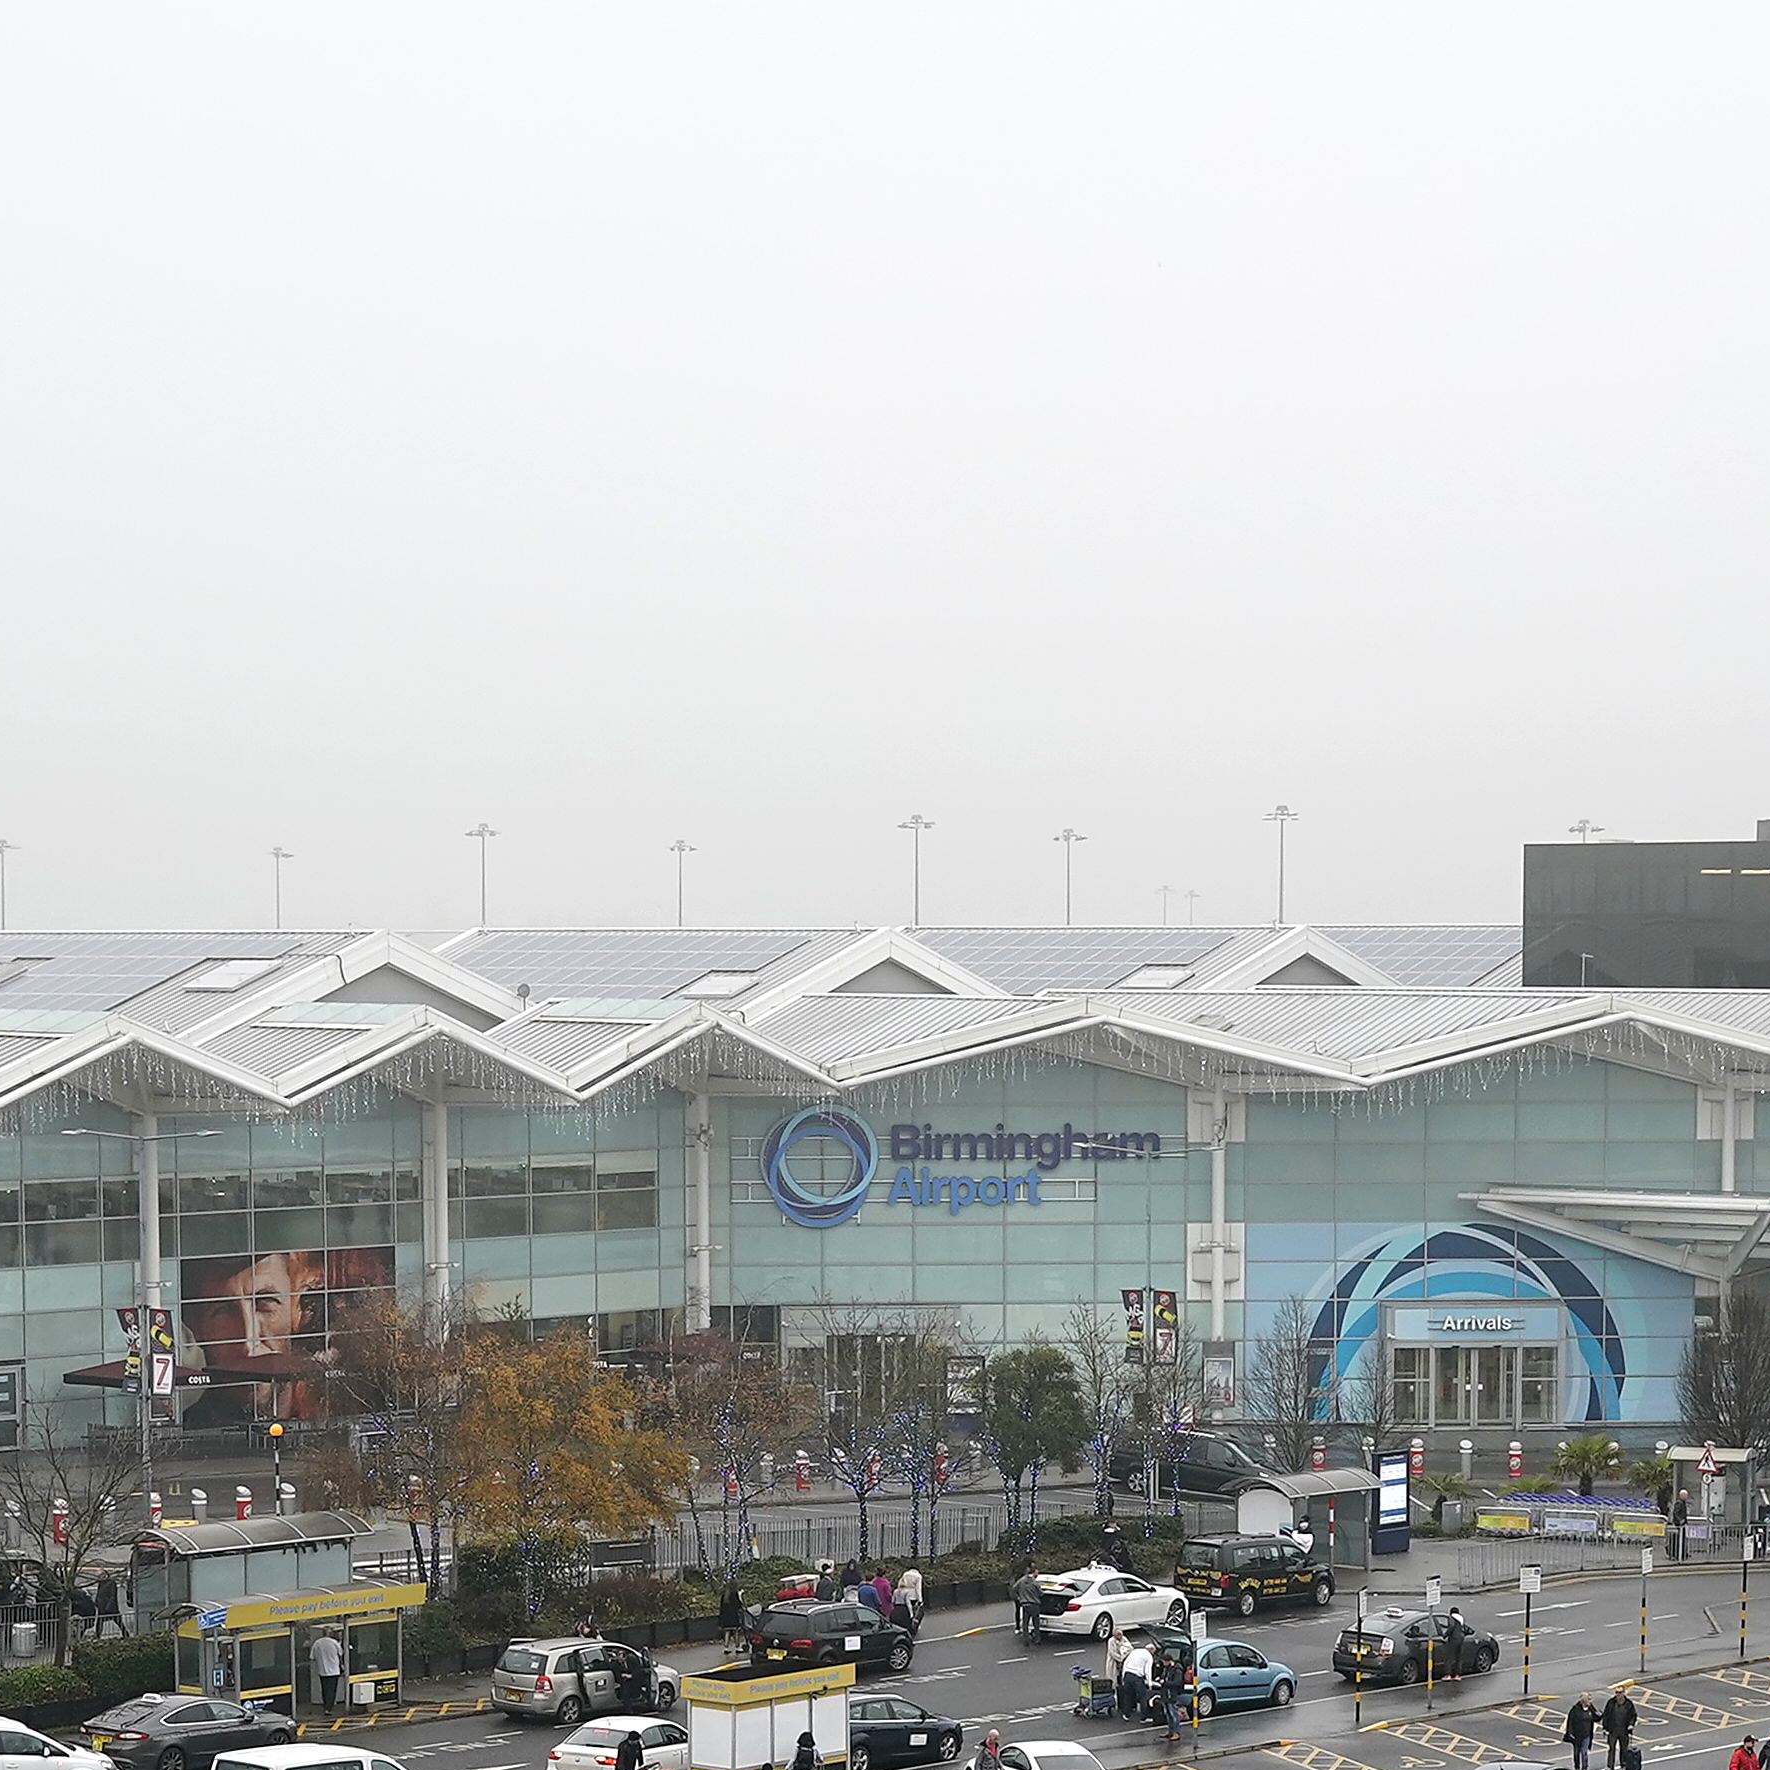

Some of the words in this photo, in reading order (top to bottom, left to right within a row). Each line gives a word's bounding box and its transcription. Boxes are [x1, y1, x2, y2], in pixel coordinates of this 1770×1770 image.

[890, 1123, 1161, 1169] Birmingham
[888, 1167, 1042, 1214] Airport
[1443, 1314, 1512, 1332] Arrivals
[188, 1374, 211, 1384] COSTA
[269, 1604, 299, 1615] Please
[302, 1603, 317, 1614] pay
[320, 1598, 349, 1609] before
[351, 1597, 365, 1607] you
[368, 1593, 383, 1603] exit
